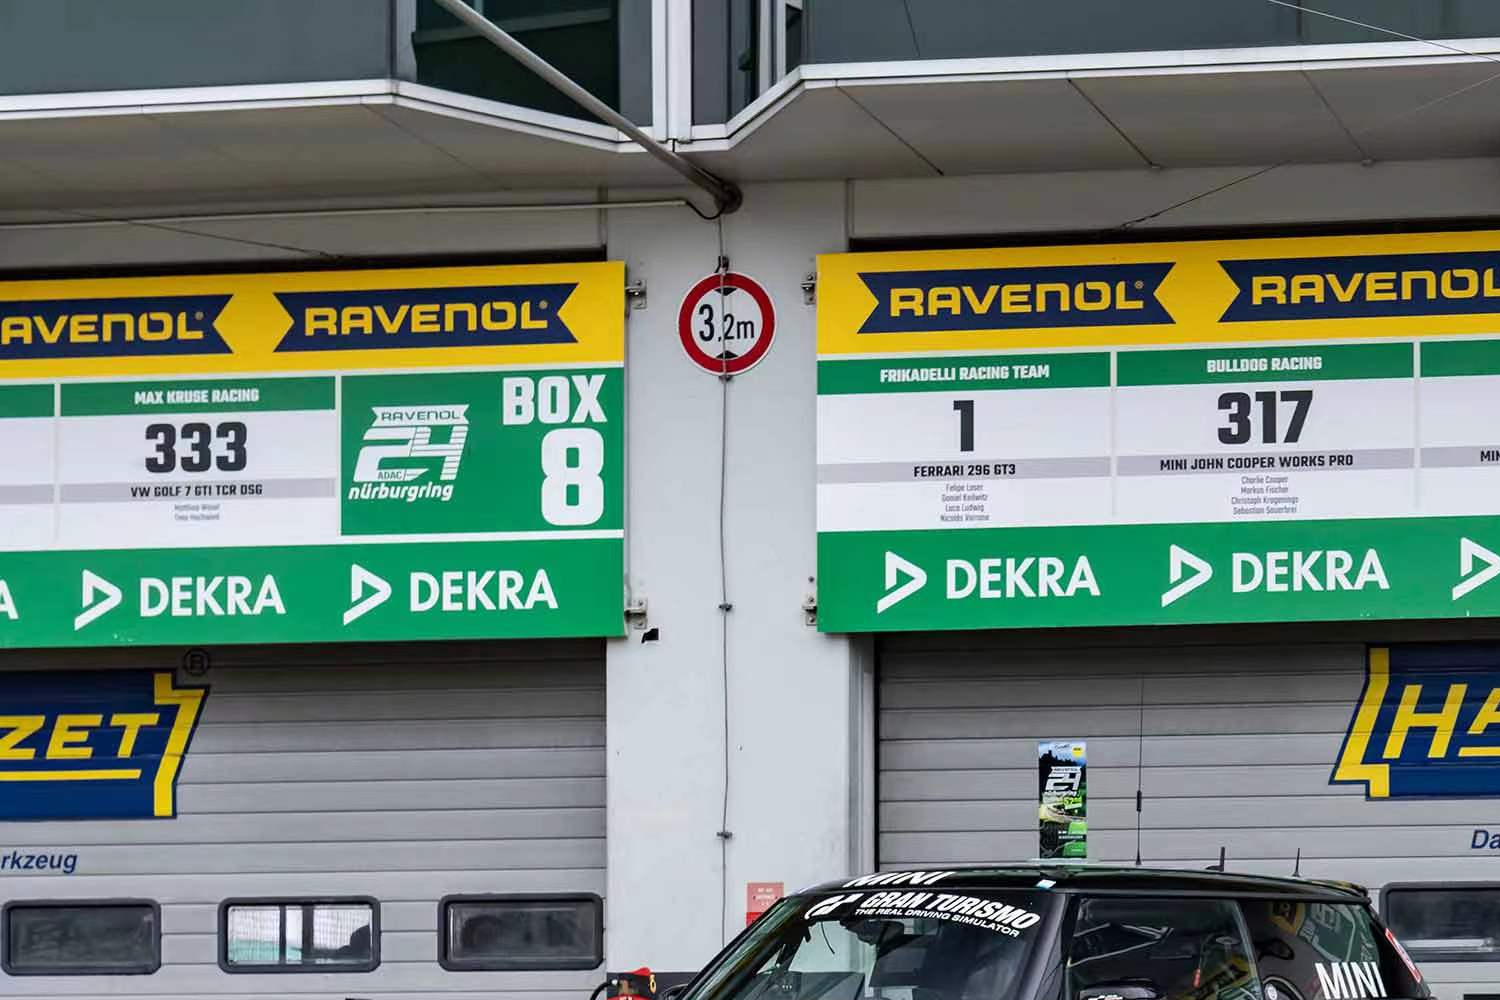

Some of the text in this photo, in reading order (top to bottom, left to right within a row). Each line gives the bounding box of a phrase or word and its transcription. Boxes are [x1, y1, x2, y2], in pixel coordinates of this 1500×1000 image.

[890, 281, 1144, 317] RAVENOL
[304, 303, 548, 338] RAVENOL
[698, 304, 755, 343] 3,2m
[880, 364, 1050, 383] FRIKADELLI RACING TEAM
[1207, 356, 1322, 373] BULLDOG RACING
[134, 388, 260, 405] MAX KRUSE RACING
[503, 374, 607, 425] BOX
[381, 410, 461, 422] RAVENOL
[953, 399, 975, 452] 1
[1217, 390, 1313, 445] 317
[145, 421, 248, 474] 333
[1160, 453, 1354, 471] MINI JOHN COOPER WORKS PRO
[378, 471, 402, 481] ADAC
[541, 428, 604, 527] 8
[913, 463, 1016, 478] FERRARI 296 GT3
[131, 484, 263, 498] VW GOLF 7 GTI TCR DSG
[348, 480, 454, 502] nürburgring
[946, 555, 1101, 600] DEKRA
[1232, 548, 1390, 593] DEKRA
[140, 574, 286, 618] DEKRA
[410, 569, 559, 612] DEKRA
[0, 713, 160, 760] ZET
[0, 850, 79, 874] rkzeug
[842, 872, 956, 888] MINI
[855, 908, 1021, 938] THE REAL DRIVING SIMULATOR
[860, 891, 1041, 930] GRAN TURISMO
[1314, 962, 1388, 1000] MINI
